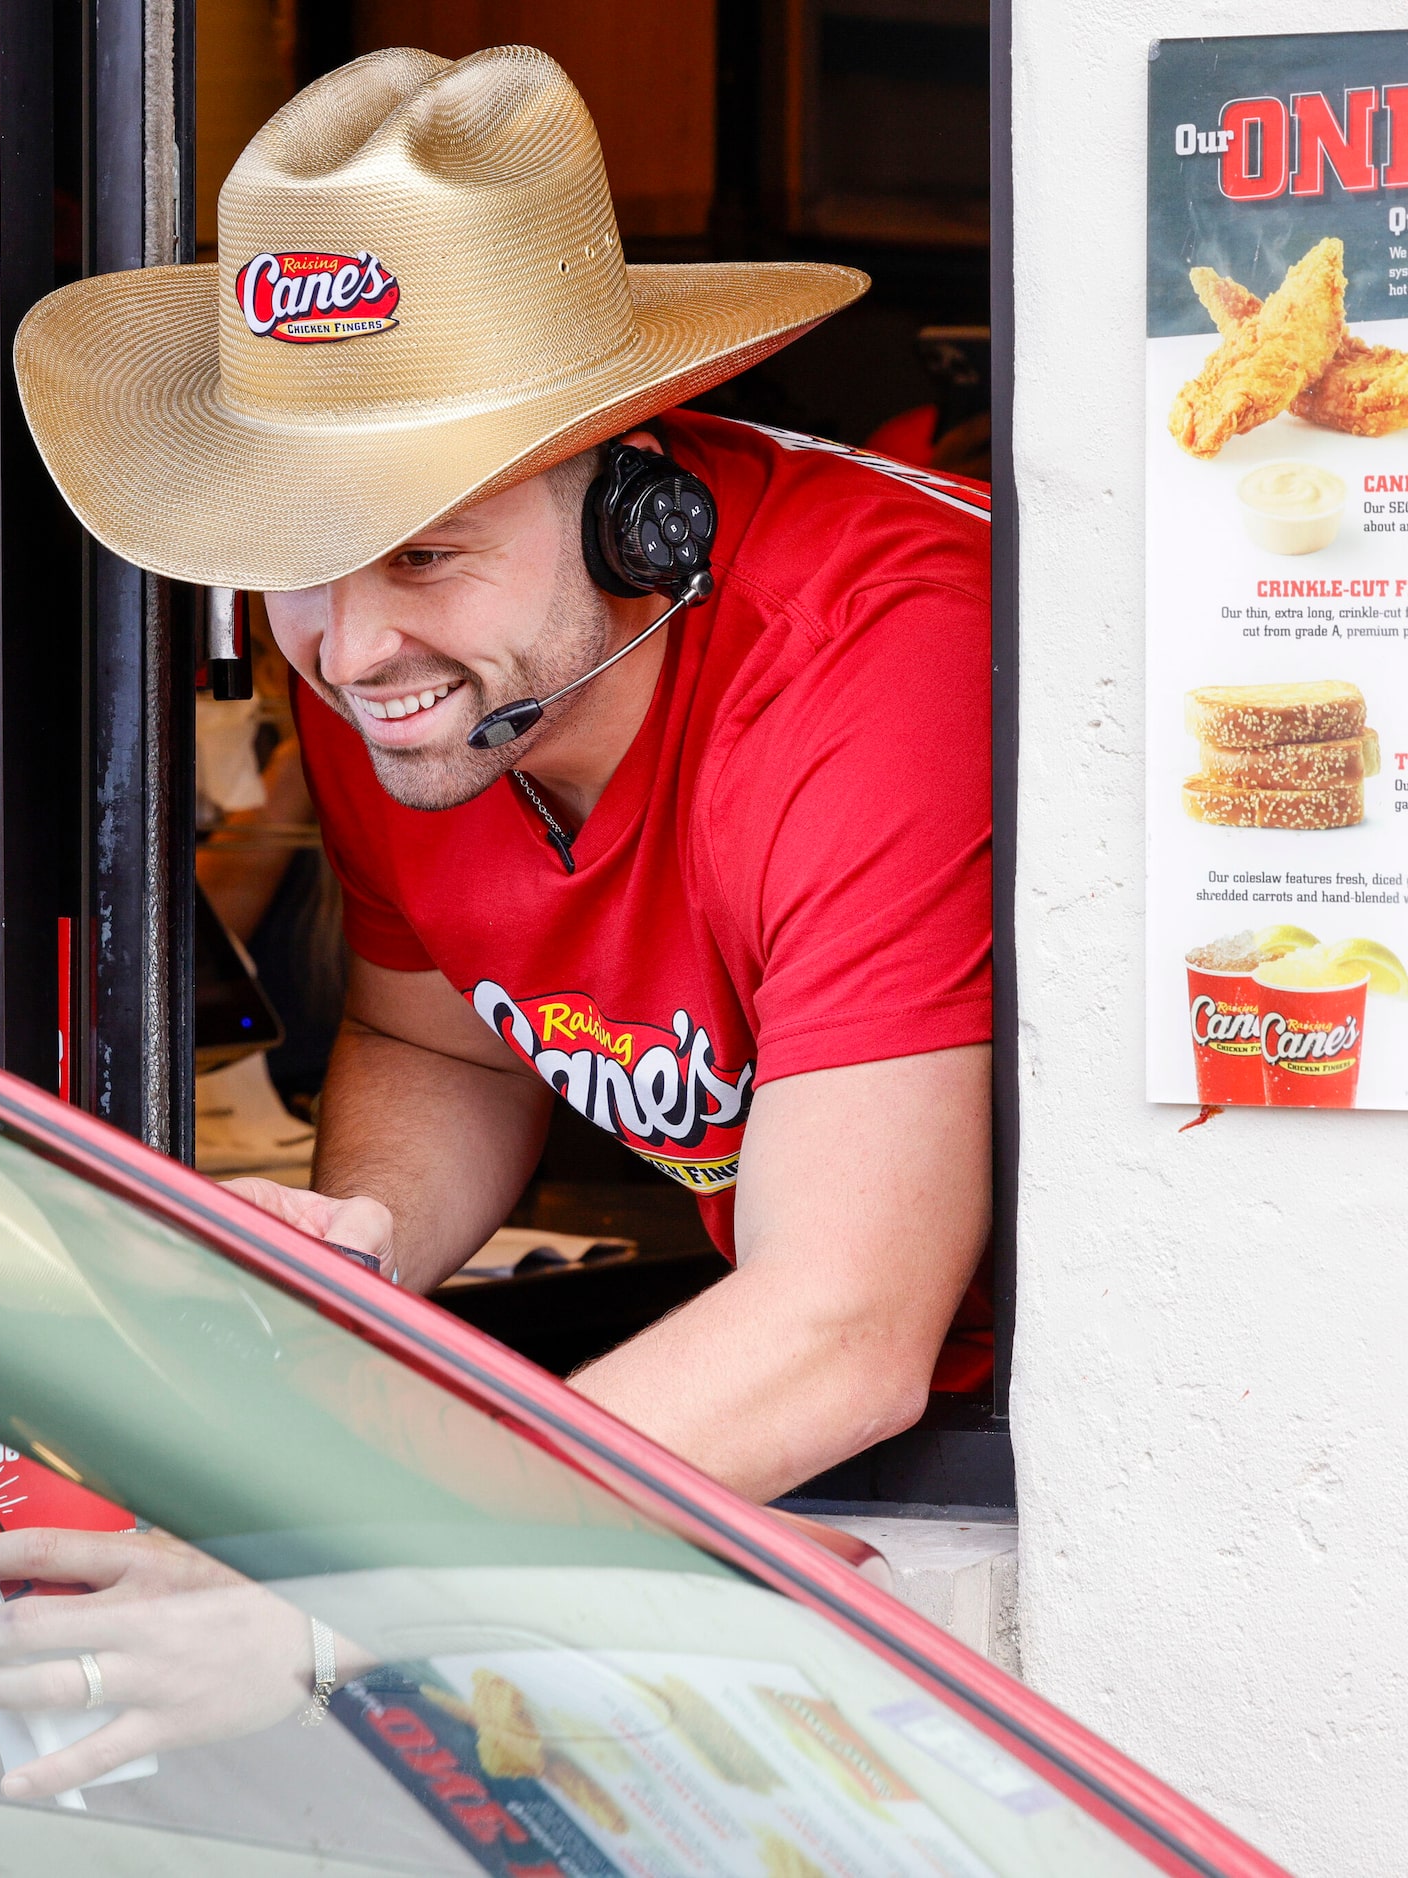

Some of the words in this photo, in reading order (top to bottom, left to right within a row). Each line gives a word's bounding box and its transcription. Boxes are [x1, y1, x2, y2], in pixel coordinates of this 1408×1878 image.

[1175, 123, 1235, 156] Our
[1389, 206, 1408, 236] Q
[1389, 246, 1407, 260] We
[282, 257, 339, 275] Raising
[244, 251, 395, 334] Cane's
[1388, 282, 1408, 297] hot
[287, 323, 331, 334] CHICKEN
[334, 319, 383, 333] FINGERS
[1363, 475, 1408, 492] CAN
[691, 505, 702, 518] A2
[1363, 501, 1385, 514] Our
[670, 524, 678, 533] B
[1363, 520, 1396, 533] about
[647, 540, 657, 553] A1
[1257, 580, 1390, 598] CRINKLE-CUT
[1395, 580, 1408, 598] F
[1221, 606, 1242, 619] Our
[1245, 606, 1271, 621] thin,
[1274, 607, 1303, 619] extra
[1307, 606, 1335, 622] long,
[1338, 606, 1402, 619] crinkle-cut
[1242, 626, 1260, 637] cut
[1263, 625, 1291, 637] from
[1294, 625, 1328, 639] grade
[1331, 625, 1343, 639] A,
[1346, 626, 1399, 639] premium
[1208, 870, 1229, 883] Our
[1233, 871, 1282, 884] coleslaw
[1285, 872, 1332, 884] features
[1335, 872, 1369, 887] fresh,
[1372, 873, 1403, 885] diced
[1196, 889, 1248, 901] shredded
[1252, 891, 1293, 902] carrots
[1296, 890, 1318, 903] and
[1321, 891, 1400, 904] hand-blended
[1216, 1001, 1259, 1014] Raising
[1287, 1018, 1333, 1033] Raising
[537, 1002, 633, 1066] Raising
[1260, 1012, 1360, 1065] Cane's
